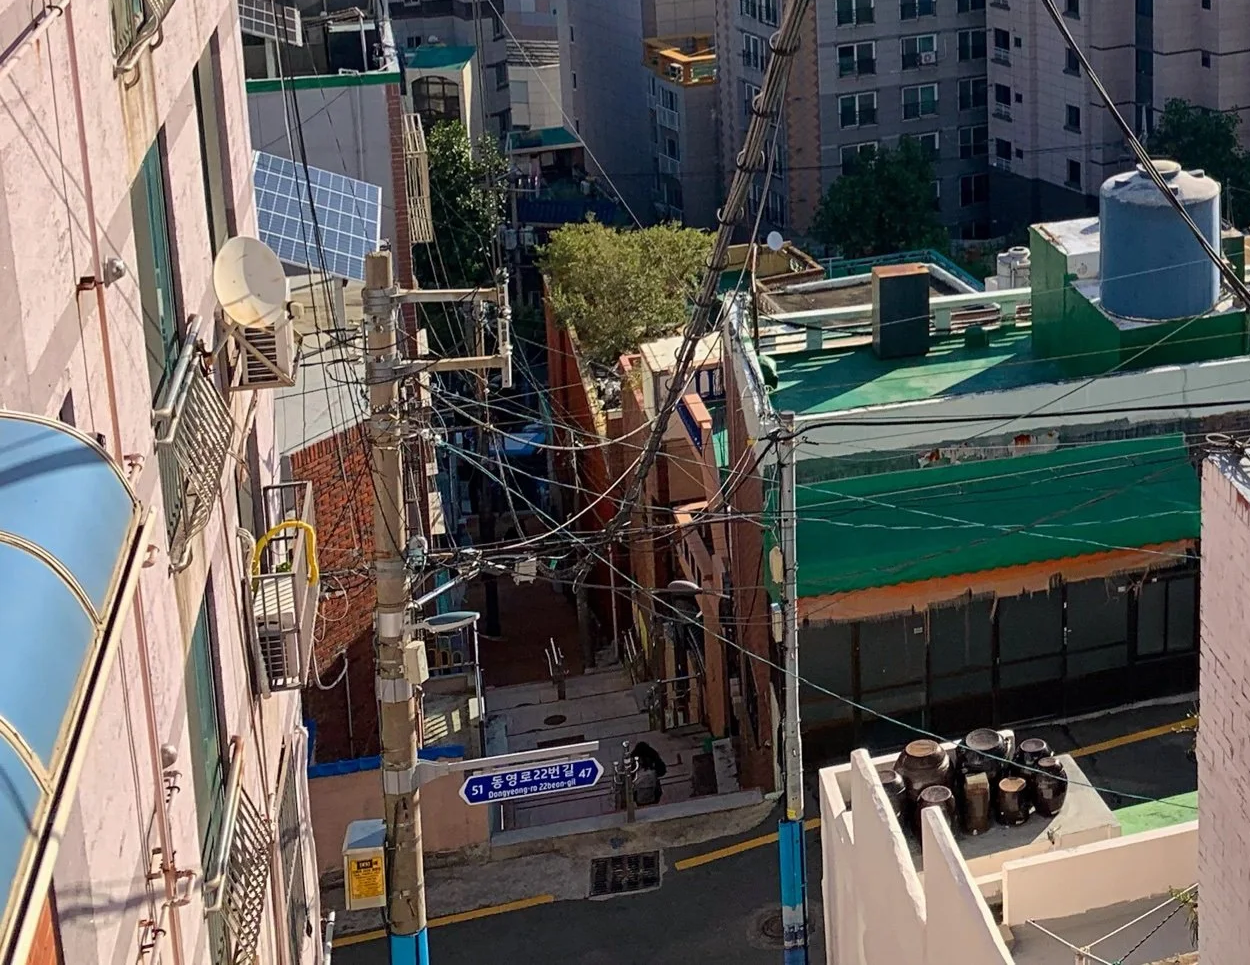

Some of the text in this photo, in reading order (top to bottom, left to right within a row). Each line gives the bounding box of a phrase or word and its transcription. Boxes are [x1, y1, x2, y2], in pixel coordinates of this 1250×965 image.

[471, 764, 592, 796] 51 동영로22번길 47
[488, 778, 576, 799] Dongyeong-ro 22beon-gil
